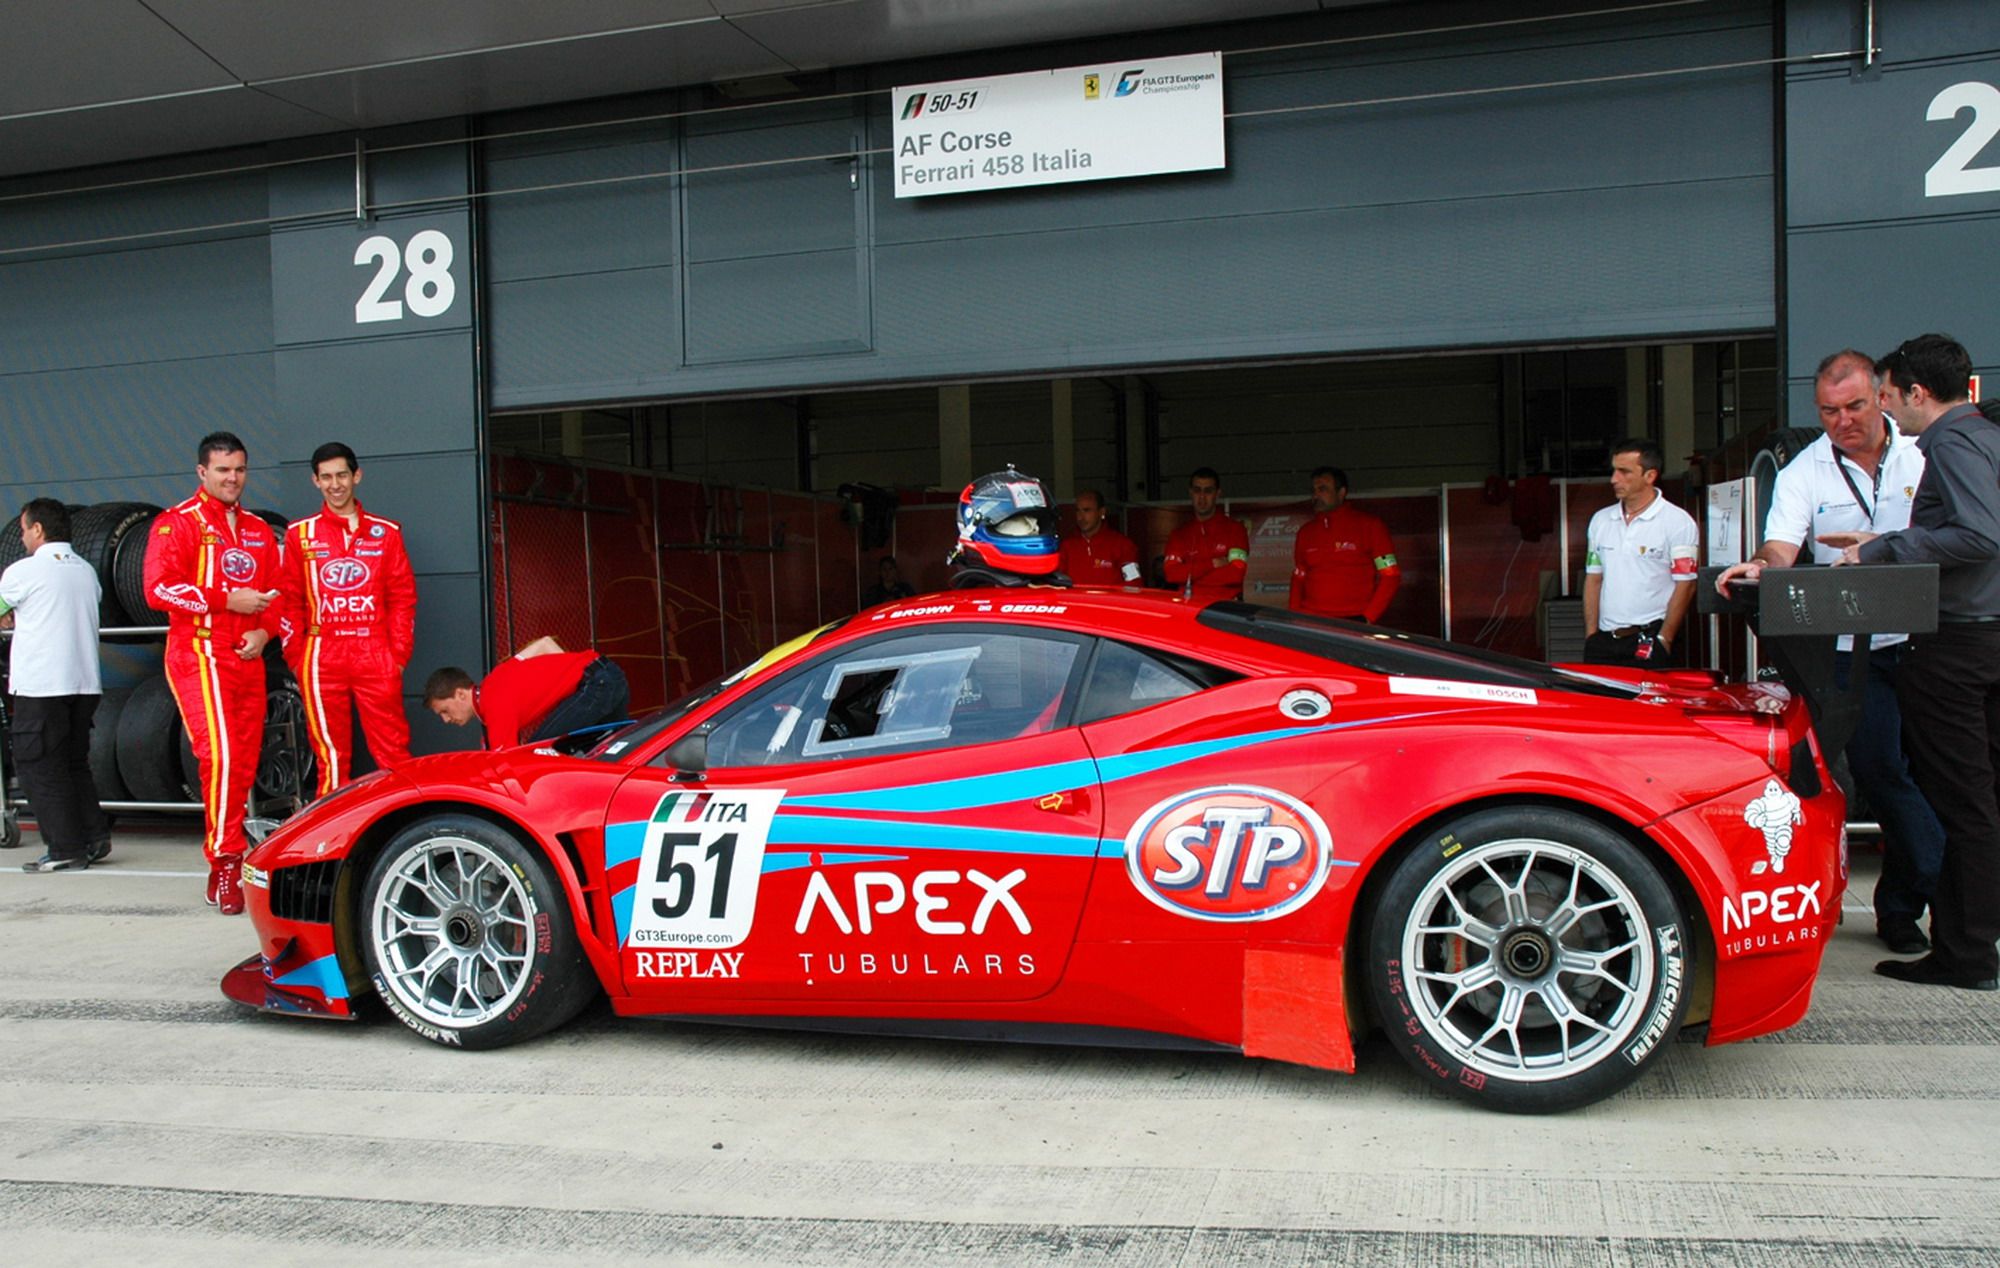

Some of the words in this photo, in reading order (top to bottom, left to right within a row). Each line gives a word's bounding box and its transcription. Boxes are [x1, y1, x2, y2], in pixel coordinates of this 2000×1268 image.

[1143, 83, 1200, 94] Championship
[1176, 73, 1215, 83] European
[929, 91, 978, 113] 50-51
[900, 134, 932, 157] AF
[940, 130, 1012, 153] Corse
[1925, 81, 2000, 197] 2
[901, 159, 974, 185] Ferrari
[982, 154, 1024, 176] 458
[1032, 149, 1092, 172] Italia
[354, 229, 456, 323] 28
[325, 562, 363, 585] STP
[321, 594, 375, 613] APEX
[890, 605, 955, 618] BROWN
[1000, 604, 1067, 614] GEDDIE
[1487, 689, 1528, 699] BOSCH
[704, 803, 747, 822] ITA
[1154, 806, 1305, 898] STP
[652, 833, 739, 919] 51
[795, 868, 1032, 935] APEX
[1722, 880, 1821, 935] APEX
[635, 929, 733, 944] GT3Europe.com
[1726, 926, 1818, 956] TUBULARS
[635, 952, 744, 978] REPLAY
[798, 953, 1036, 975] TUBULARS
[1631, 956, 1682, 1062] MICHELIN
